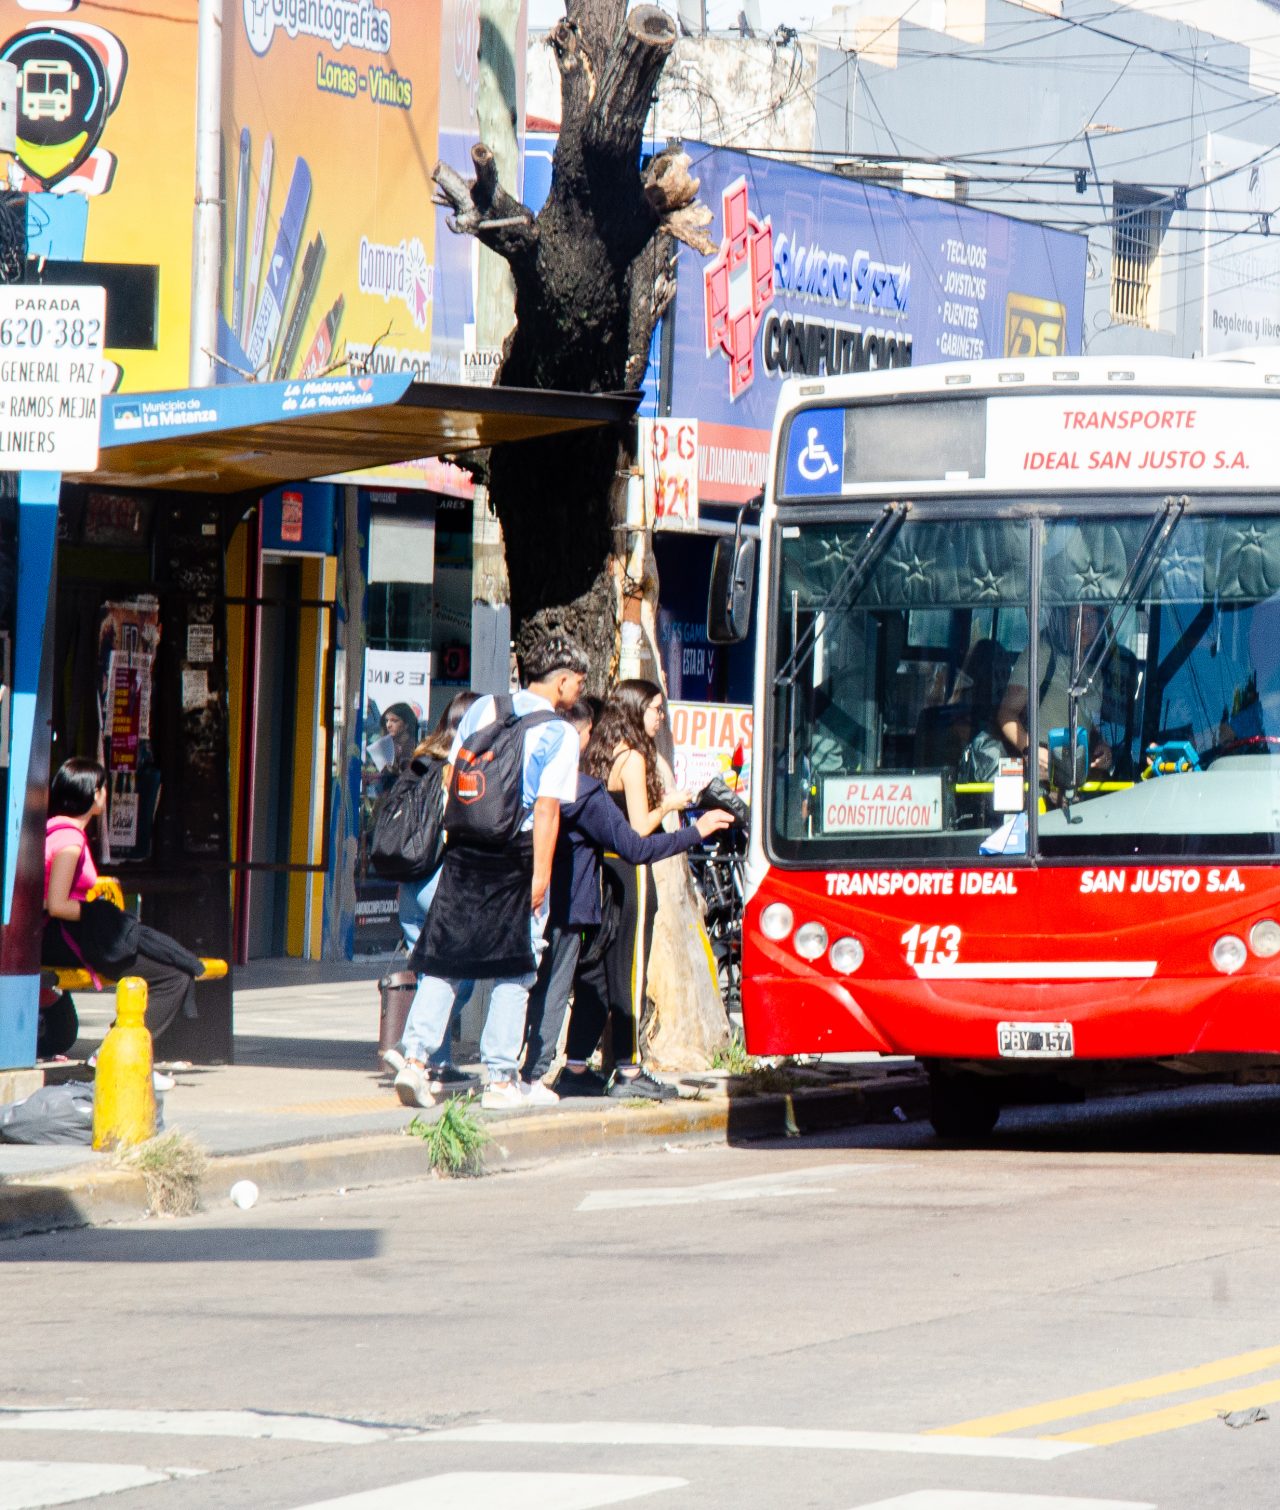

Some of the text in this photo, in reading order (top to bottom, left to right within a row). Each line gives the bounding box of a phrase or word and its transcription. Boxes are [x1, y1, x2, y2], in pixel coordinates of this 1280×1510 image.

[317, 53, 357, 97] Lonas
[368, 66, 412, 109] Vinilos
[946, 239, 988, 269] TECLADOS
[943, 271, 987, 300] JOYSTICKS
[15, 299, 81, 311] PARADA
[942, 301, 979, 330] FUENTES
[940, 332, 984, 359] GABINETES
[1, 361, 95, 384] GENERAL PAZ
[284, 383, 301, 396] La
[10, 395, 54, 419] RAMOS
[58, 396, 96, 419] MEJIA
[142, 399, 200, 412] Municipio de
[282, 393, 374, 410] de La Provincia
[143, 408, 217, 427] La Matanza
[1063, 410, 1196, 429] TRANSPORTE
[1023, 451, 1250, 470] IDEAL SAN JUSTO S.A.
[672, 708, 753, 750] OPIAS
[847, 784, 913, 801] PLAZA
[827, 804, 931, 826] CONSTITUCION
[825, 872, 1017, 896] TRANSPORTE IDEAL
[1080, 870, 1246, 893] SAN JUSTO S.A.
[901, 924, 961, 966] 113
[1001, 1031, 1069, 1052] PBY 157
